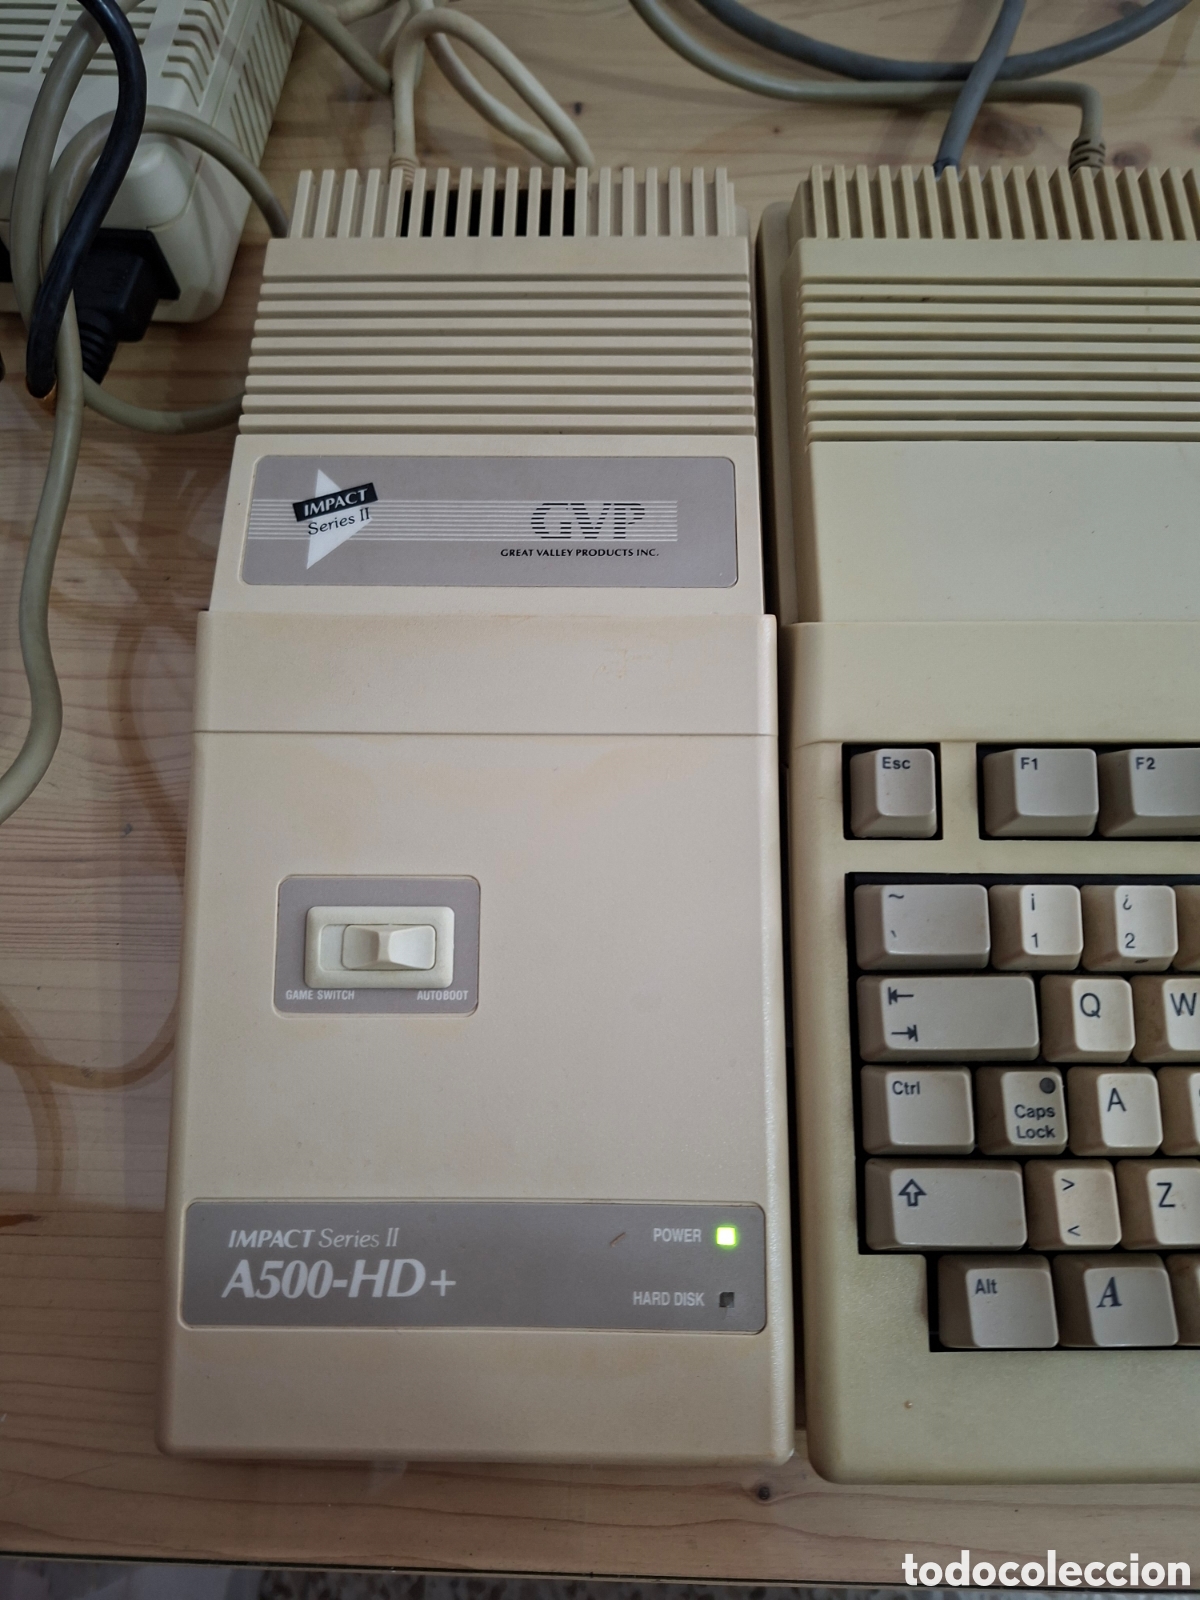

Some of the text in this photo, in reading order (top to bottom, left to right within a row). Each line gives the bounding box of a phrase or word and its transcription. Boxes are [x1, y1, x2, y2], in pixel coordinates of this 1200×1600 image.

[304, 488, 368, 517] IMPACT
[308, 507, 370, 535] Series II
[530, 502, 646, 540] GVP
[500, 548, 660, 557] GREAT VALLEY PRODUCTS INC.
[881, 756, 911, 770] Esc
[1020, 757, 1038, 770] F1
[1135, 757, 1156, 770] F2
[1030, 933, 1039, 949] 1
[1124, 933, 1136, 949] 2
[285, 990, 355, 1001] GAME SWITCH
[416, 991, 469, 1001] AUTOBOOT
[1079, 993, 1101, 1018] Q
[1170, 992, 1197, 1017] W
[892, 1080, 921, 1095] Ctrl
[1106, 1088, 1127, 1112] A
[1014, 1104, 1055, 1120] Caps
[1016, 1125, 1055, 1139] Lock
[1156, 1182, 1176, 1207] Z
[228, 1227, 400, 1248] IMPACT Series II
[652, 1228, 702, 1242] POWER
[221, 1258, 457, 1299] A500-HD+
[975, 1279, 998, 1294] Alt
[633, 1291, 705, 1306] HARD DISK
